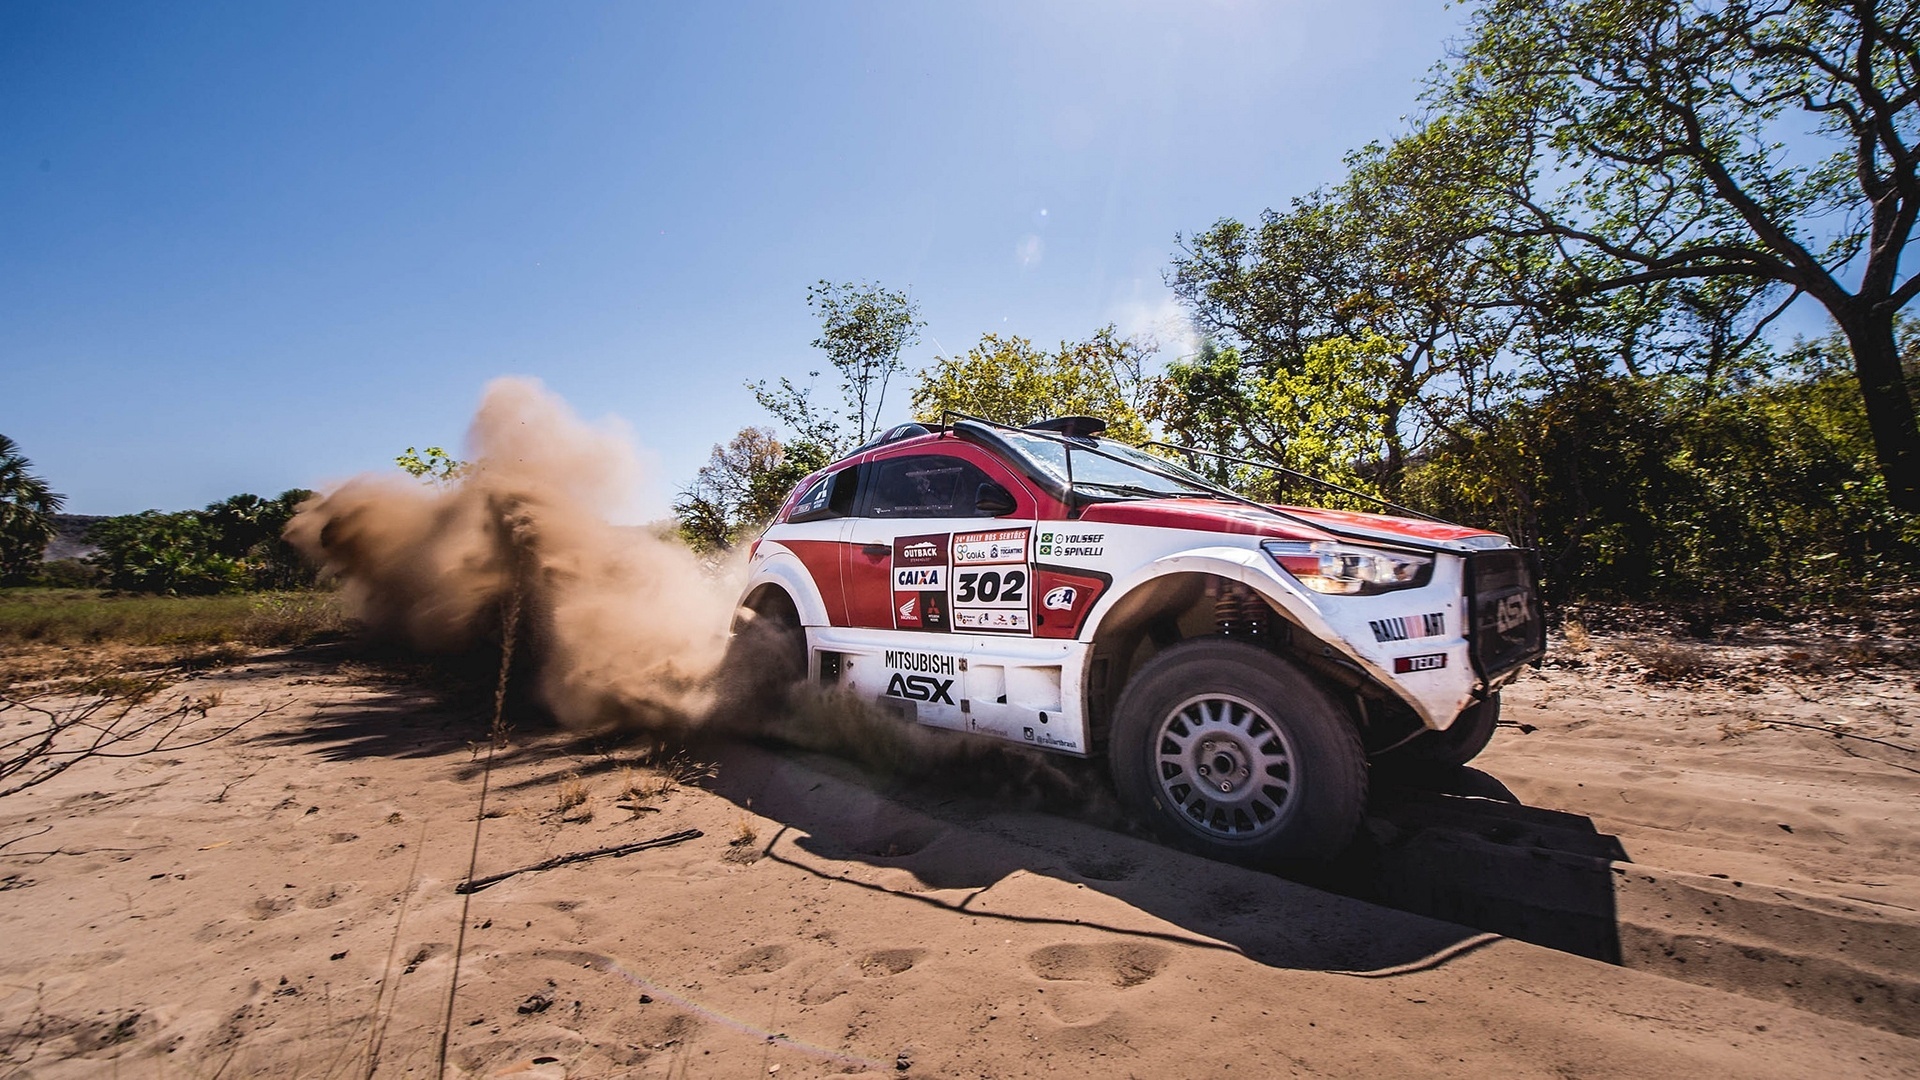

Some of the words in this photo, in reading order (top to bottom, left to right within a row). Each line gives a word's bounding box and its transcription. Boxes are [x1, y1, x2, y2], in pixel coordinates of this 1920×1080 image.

[965, 534, 982, 542] RALLY
[984, 533, 997, 541] DOS
[1065, 534, 1104, 543] YOUSSEF
[903, 547, 938, 558] OUTBACK
[965, 550, 986, 560] GOIÁS
[1064, 547, 1103, 556] SPINELLI
[898, 569, 938, 586] CAIXA
[956, 570, 1026, 603] 302
[1497, 591, 1532, 634] ASX
[885, 650, 955, 676] MITSUBISHI
[886, 672, 956, 706] ASX
